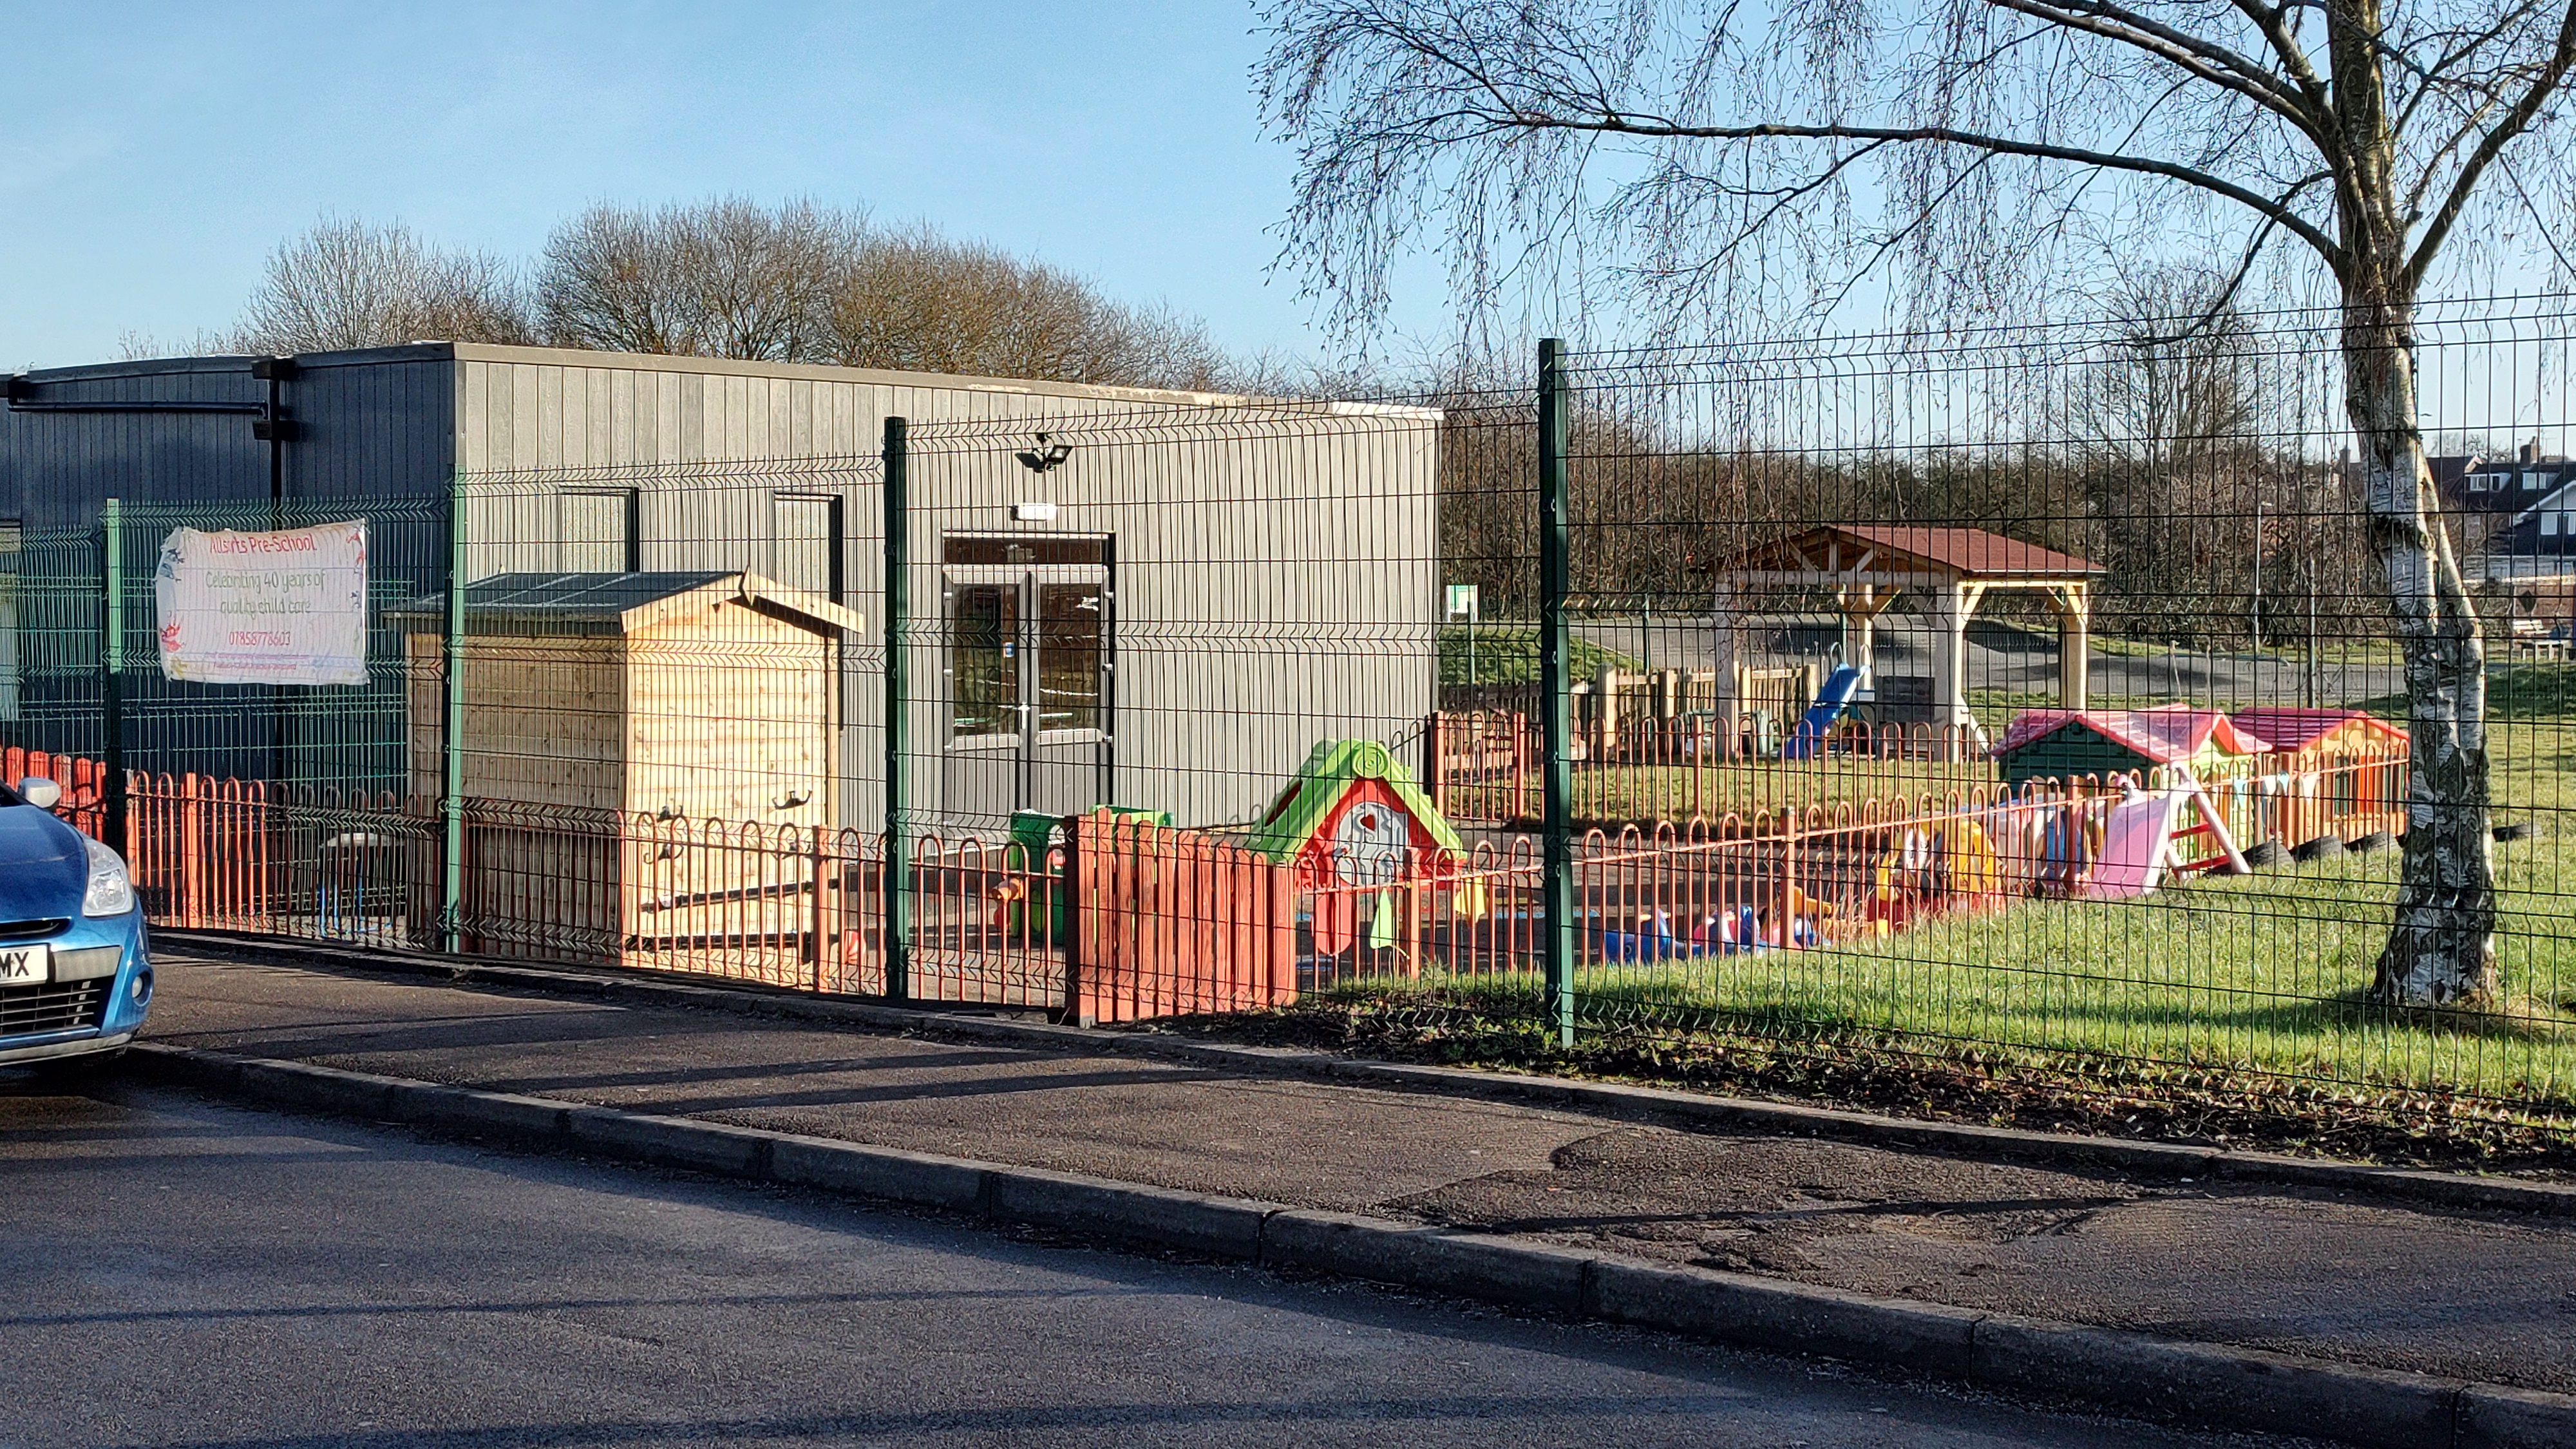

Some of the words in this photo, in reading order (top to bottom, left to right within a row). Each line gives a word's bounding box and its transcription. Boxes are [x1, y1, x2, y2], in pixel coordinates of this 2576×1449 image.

[248, 533, 317, 553] Pre-School
[264, 571, 279, 588] 40
[282, 573, 312, 593] years
[314, 571, 326, 591] of
[258, 596, 285, 614] child
